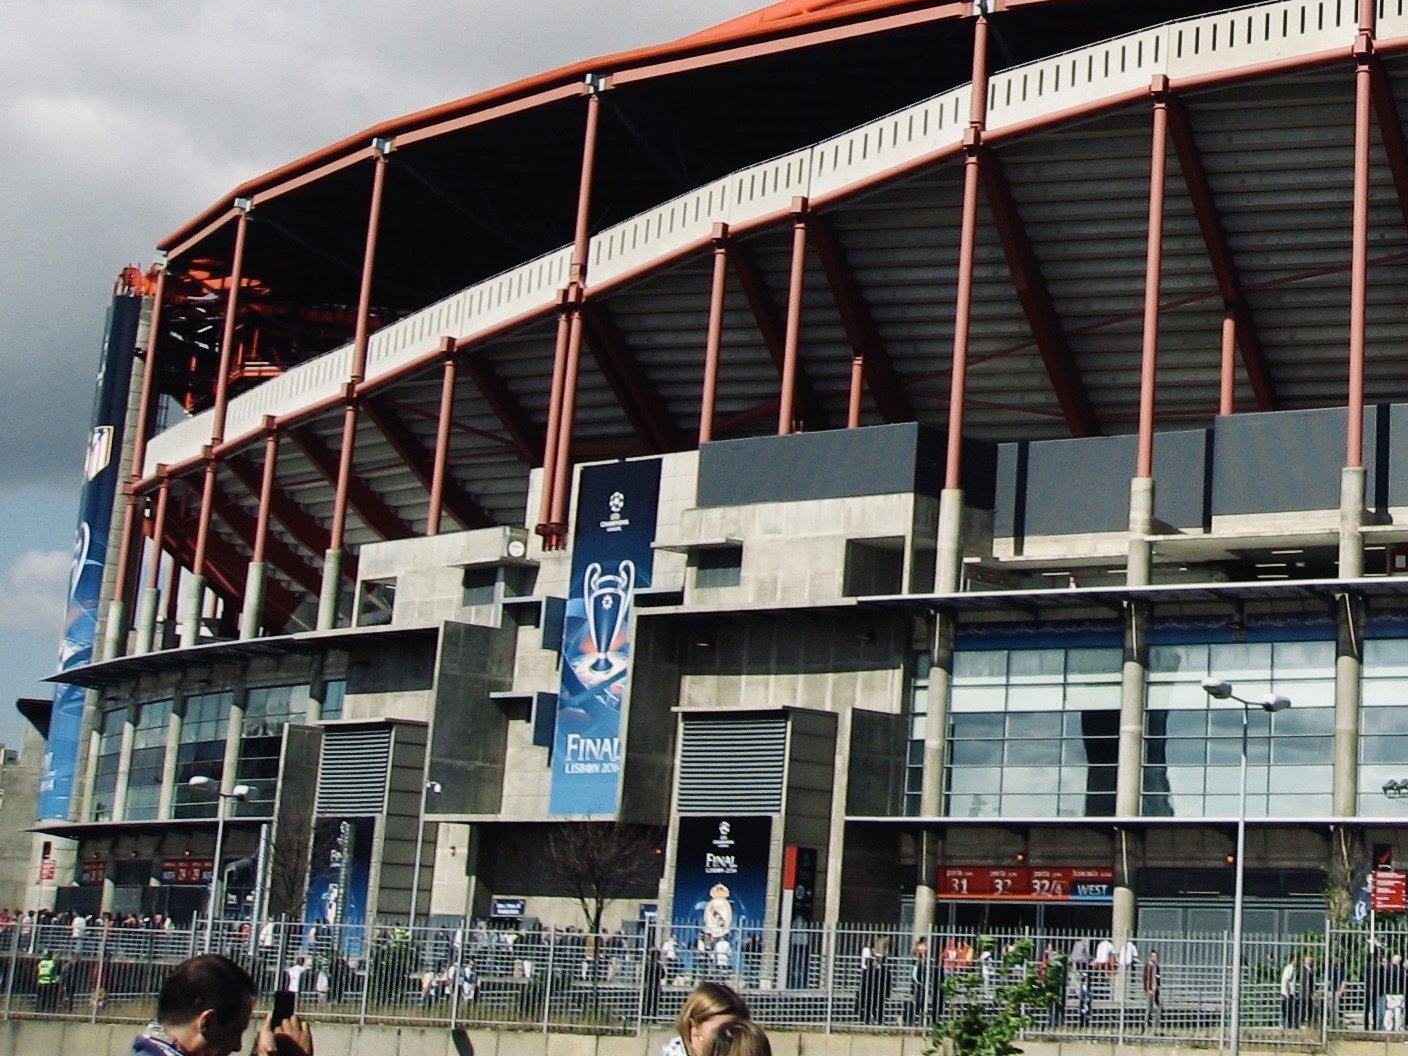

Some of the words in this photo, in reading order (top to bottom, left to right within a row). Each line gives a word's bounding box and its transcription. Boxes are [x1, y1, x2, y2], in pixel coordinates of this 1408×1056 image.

[565, 732, 621, 762] FINAL
[705, 852, 738, 868] FINAL
[951, 878, 968, 894] 31
[1077, 884, 1108, 896] WEST
